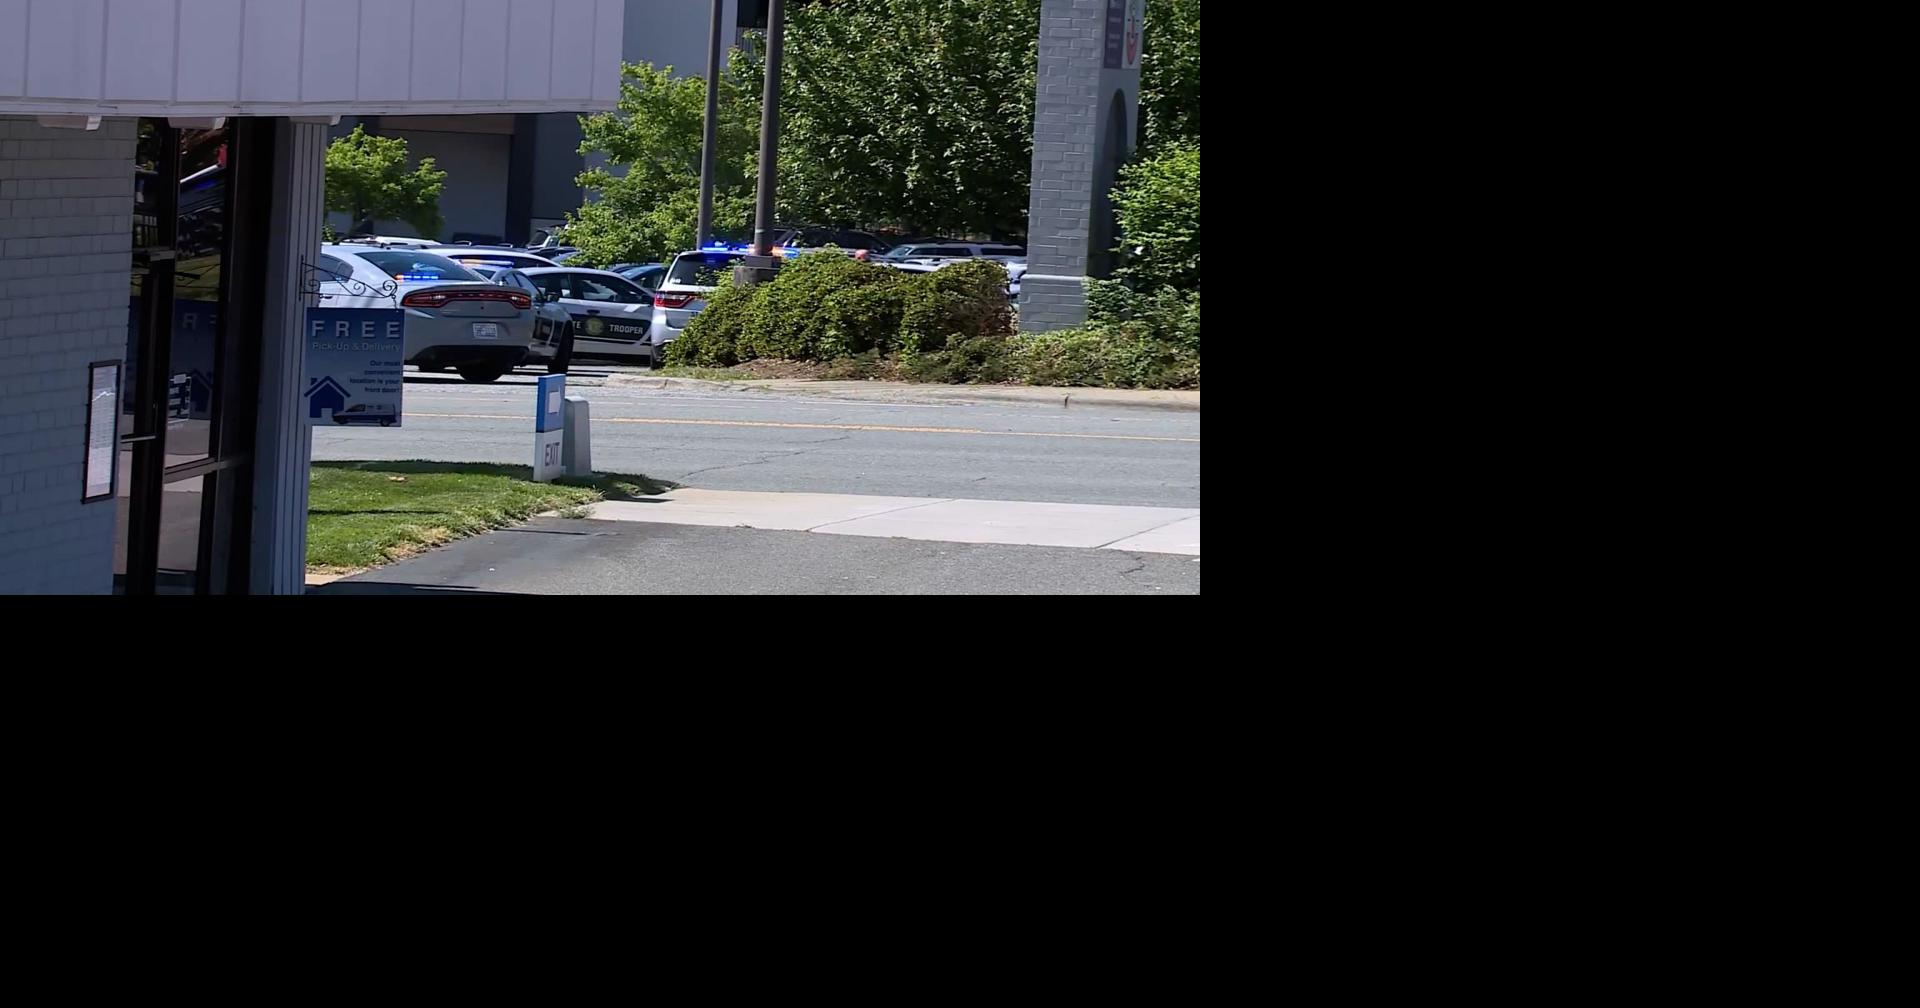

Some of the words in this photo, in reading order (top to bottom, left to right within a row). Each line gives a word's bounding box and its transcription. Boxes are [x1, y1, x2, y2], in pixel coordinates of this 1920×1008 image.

[312, 320, 400, 338] FREE
[609, 324, 643, 335] TROOPER
[361, 342, 400, 352] Delivery
[545, 442, 560, 467] EXIT
